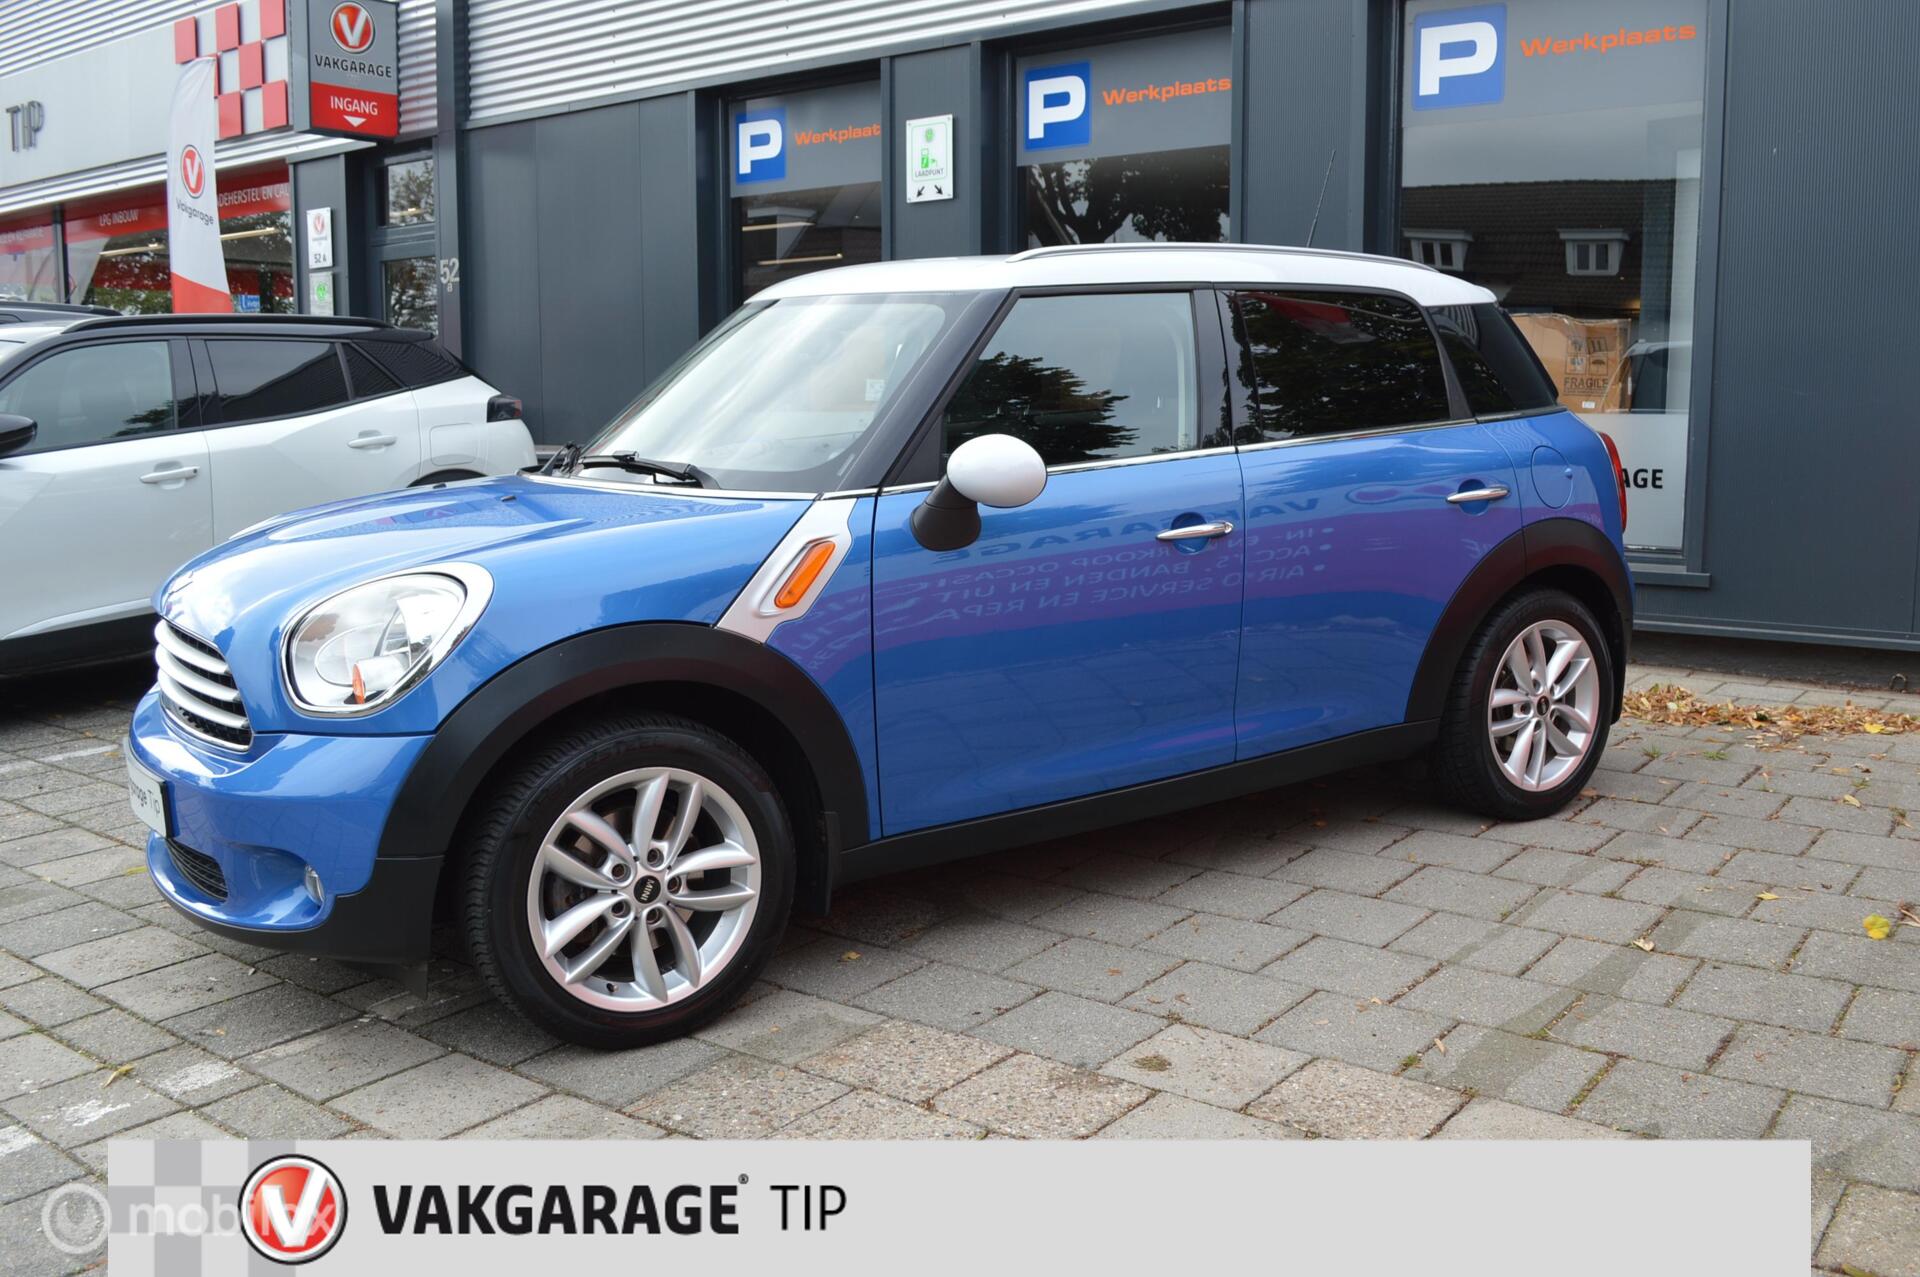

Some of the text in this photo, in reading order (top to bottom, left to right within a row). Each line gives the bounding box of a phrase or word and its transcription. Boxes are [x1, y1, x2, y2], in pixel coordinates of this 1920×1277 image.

[338, 8, 369, 47] V
[1520, 25, 1697, 57] Werkplaats
[314, 54, 392, 79] VAKGARAGE
[1419, 21, 1498, 97] P
[330, 96, 379, 116] INGANG
[1102, 77, 1232, 106] Werkplaats
[1028, 75, 1087, 140] P
[6, 100, 44, 152] TIP
[795, 123, 881, 145] Werkplaat
[738, 119, 783, 175] P
[176, 196, 215, 226] Vakgarage
[314, 253, 322, 264] 52
[440, 257, 460, 284] 52
[1563, 377, 1609, 389] FRAGILE
[640, 879, 655, 901] MINI
